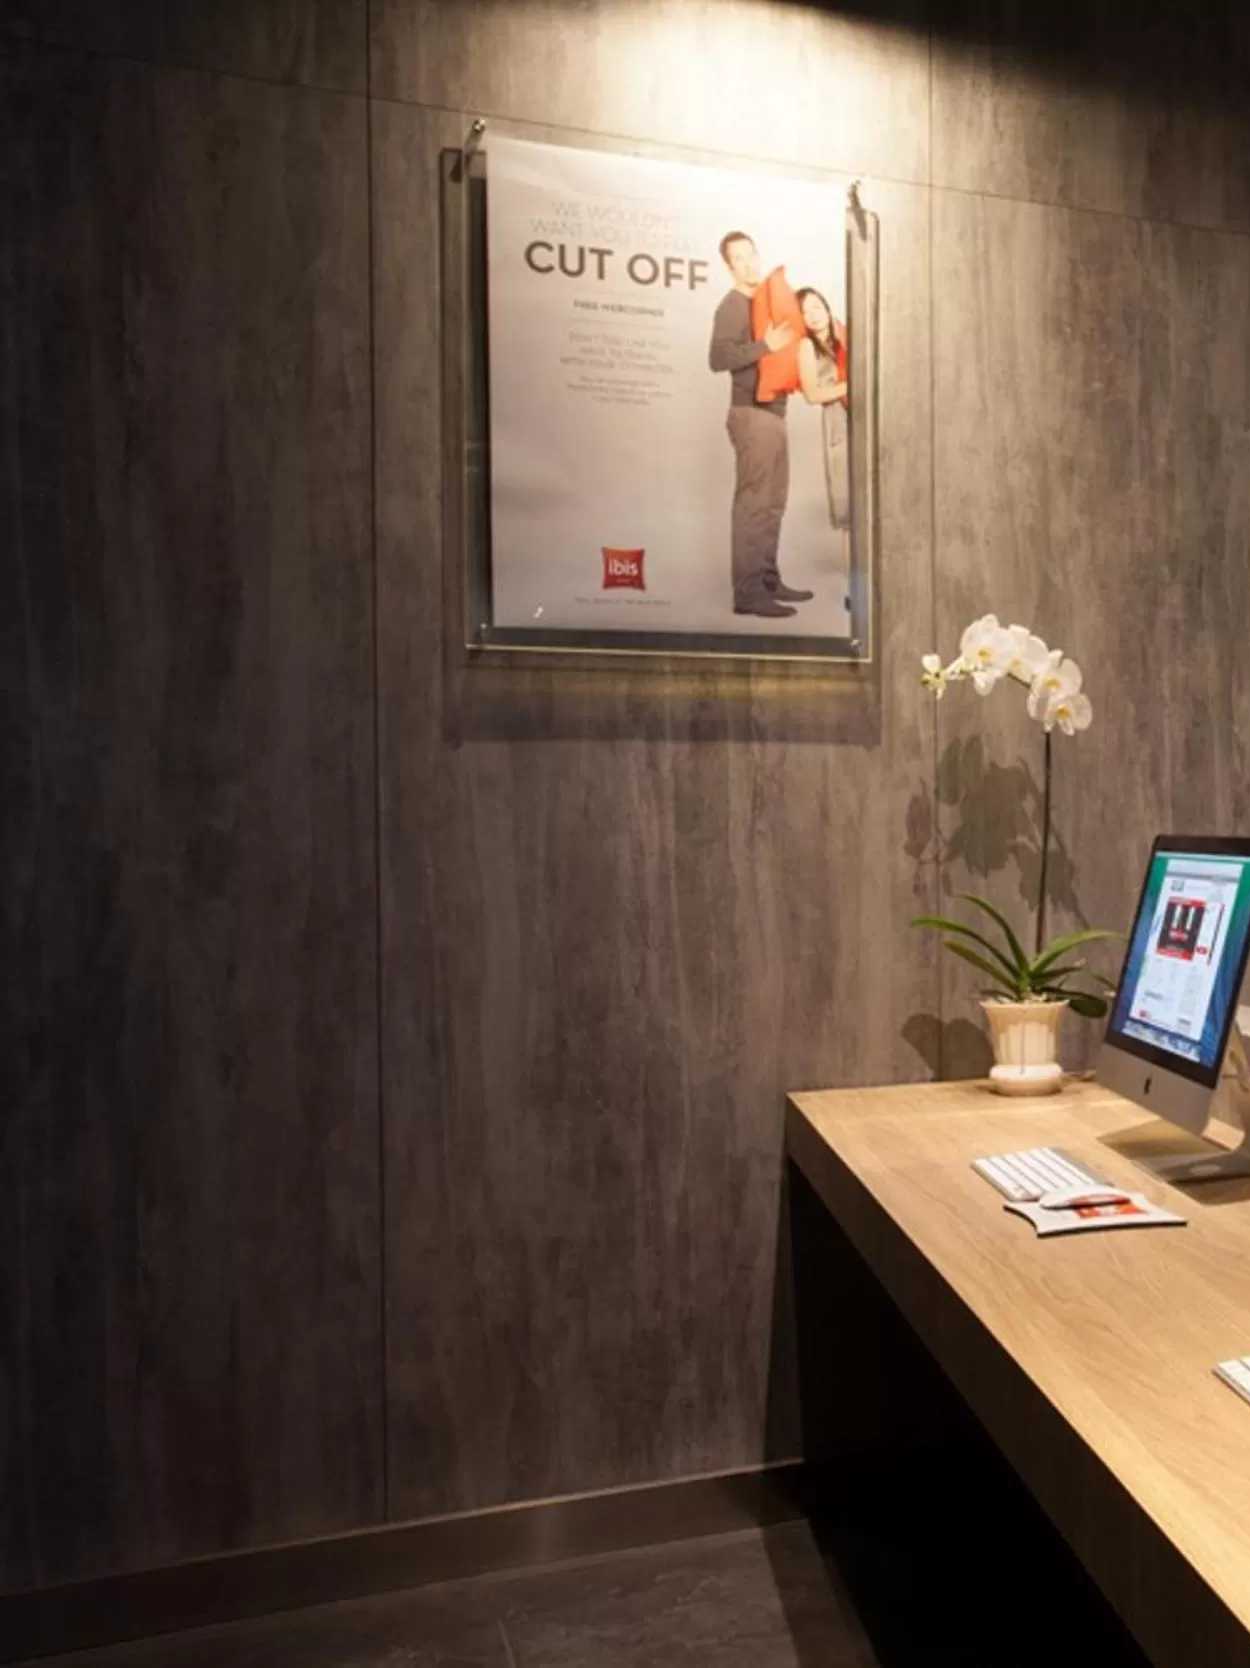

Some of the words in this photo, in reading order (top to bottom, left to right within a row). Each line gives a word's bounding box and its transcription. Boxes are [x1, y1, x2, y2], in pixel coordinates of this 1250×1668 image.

[524, 239, 614, 281] CUT
[626, 252, 710, 291] OFF
[608, 556, 639, 577] ibis
